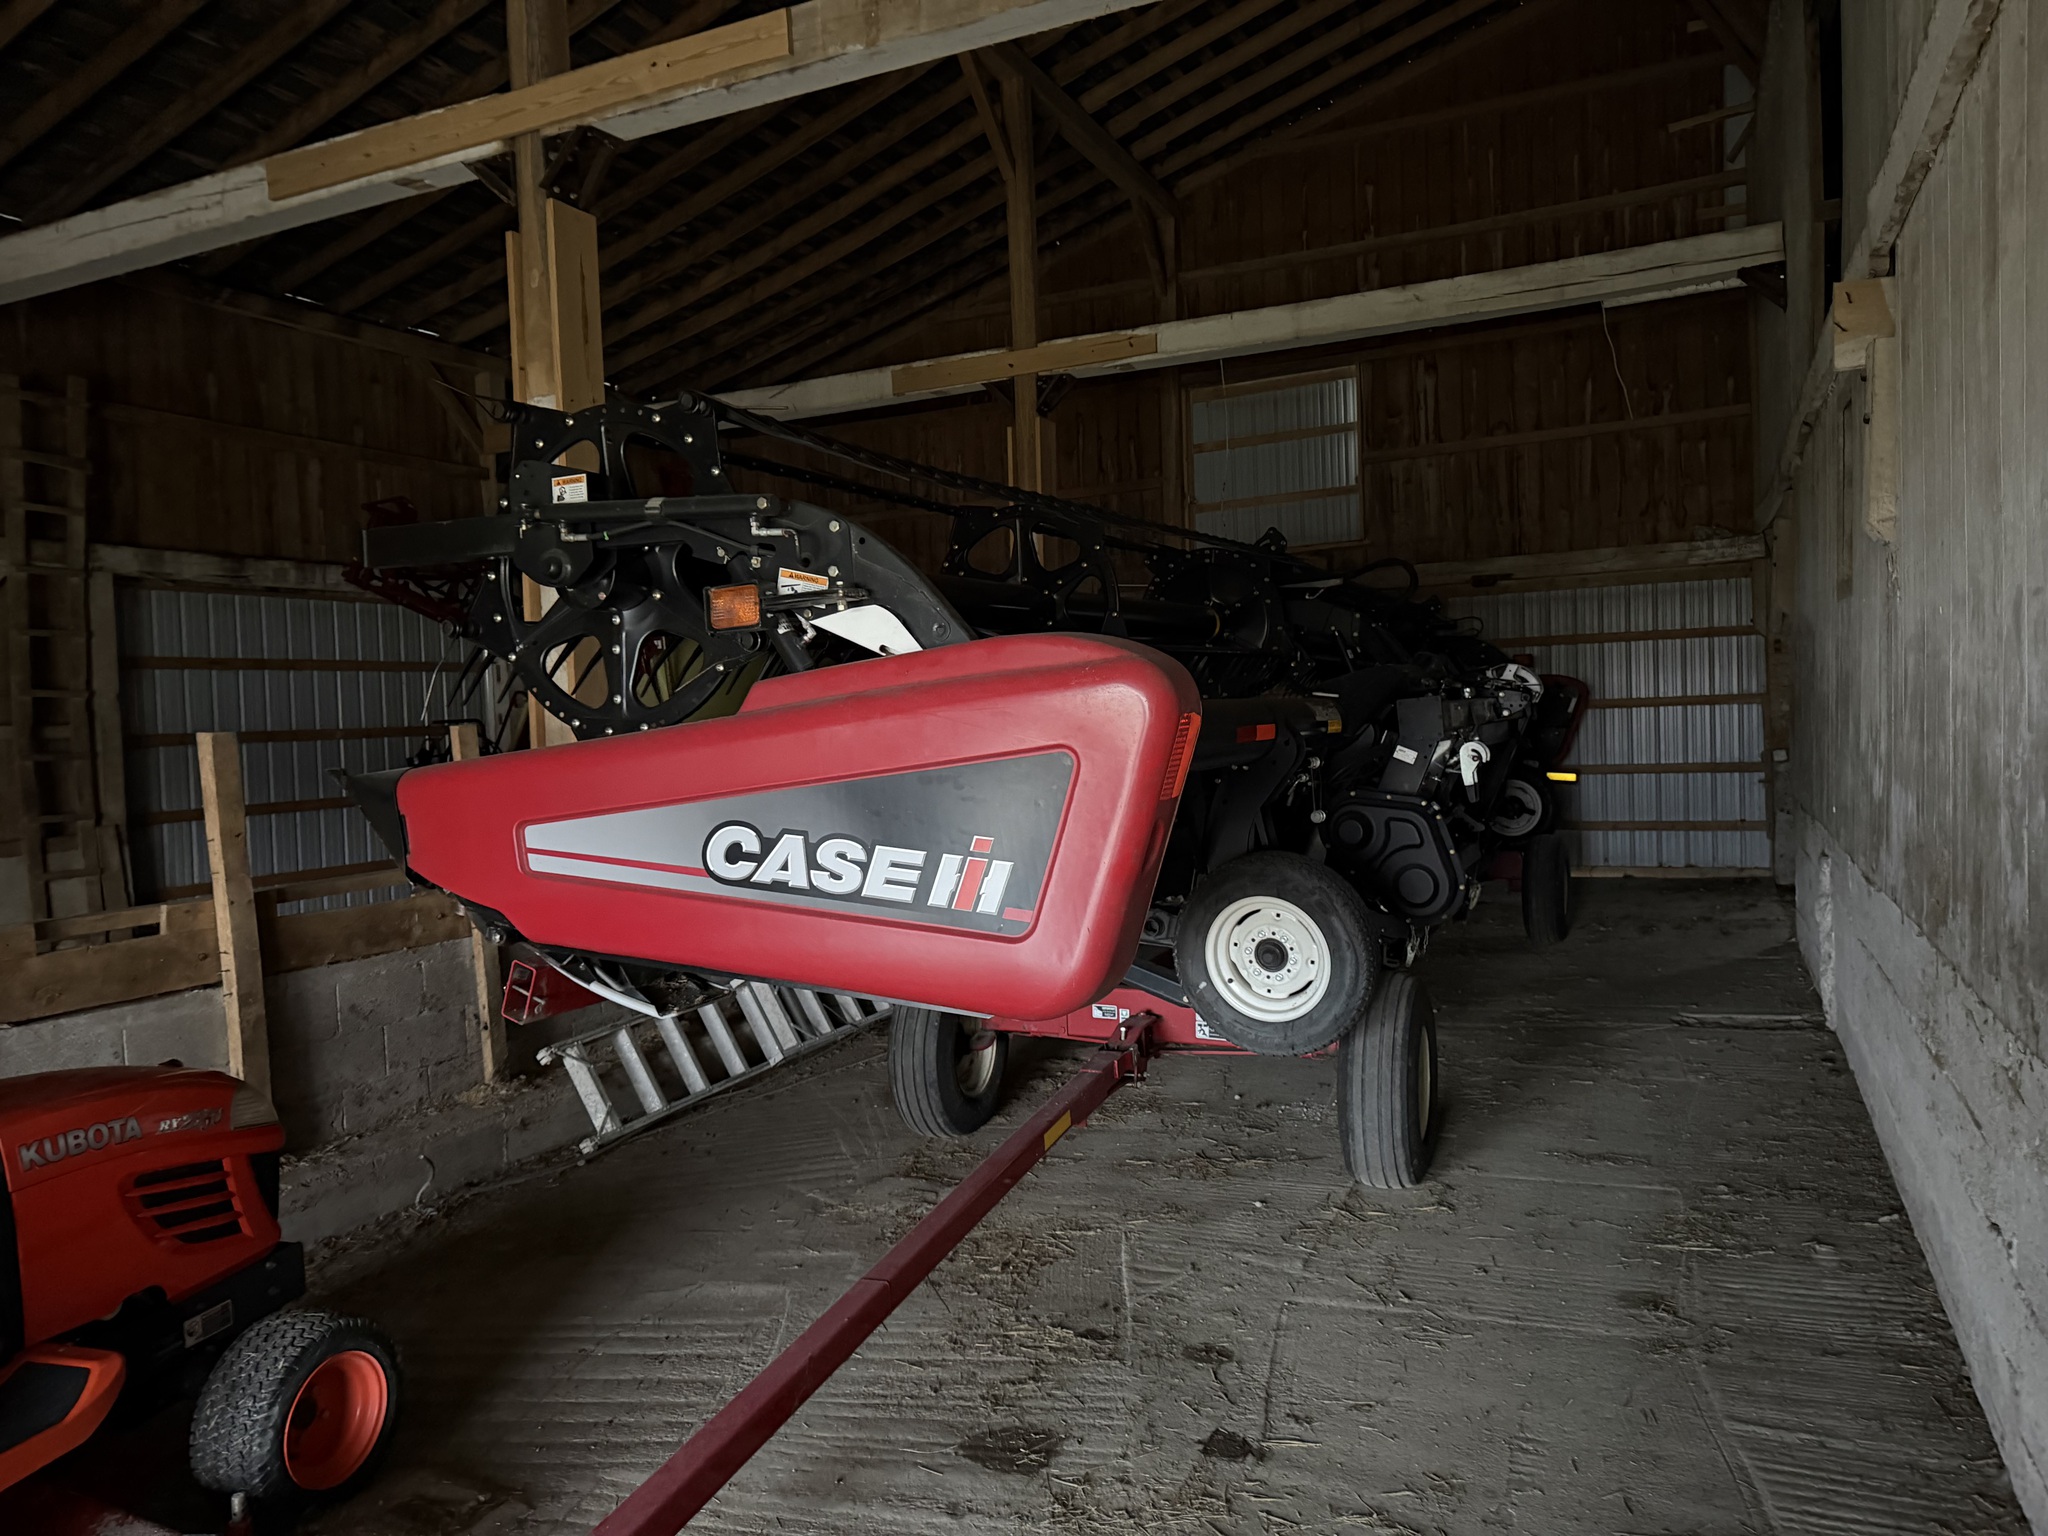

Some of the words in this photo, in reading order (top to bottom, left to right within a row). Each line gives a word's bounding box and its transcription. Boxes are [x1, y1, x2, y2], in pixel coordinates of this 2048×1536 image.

[794, 574, 819, 584] WARNING
[704, 823, 928, 904] CASE
[19, 1117, 143, 1171] KUBOTA
